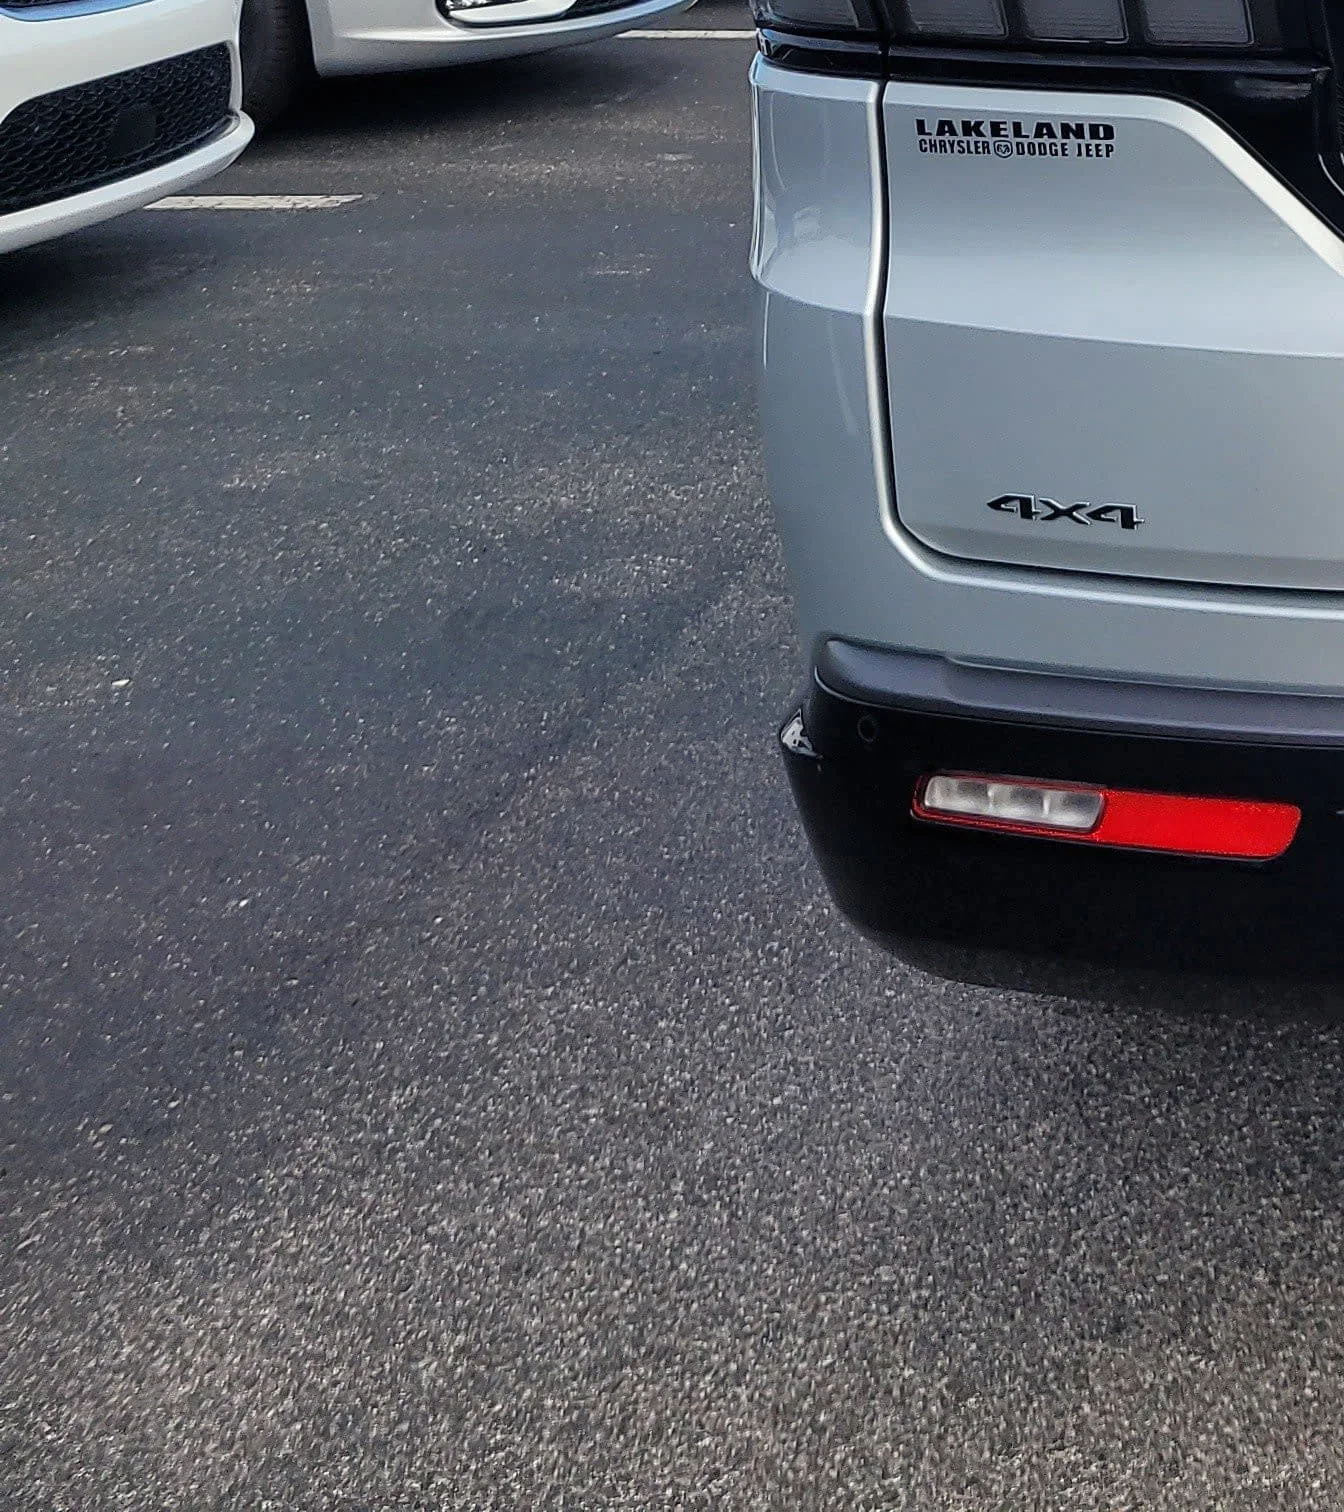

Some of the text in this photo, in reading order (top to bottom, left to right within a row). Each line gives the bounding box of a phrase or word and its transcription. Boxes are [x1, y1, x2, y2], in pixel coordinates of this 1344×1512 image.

[915, 118, 1116, 141] LAKELAND
[918, 138, 1115, 158] CHRYSLER DODGE JEEP
